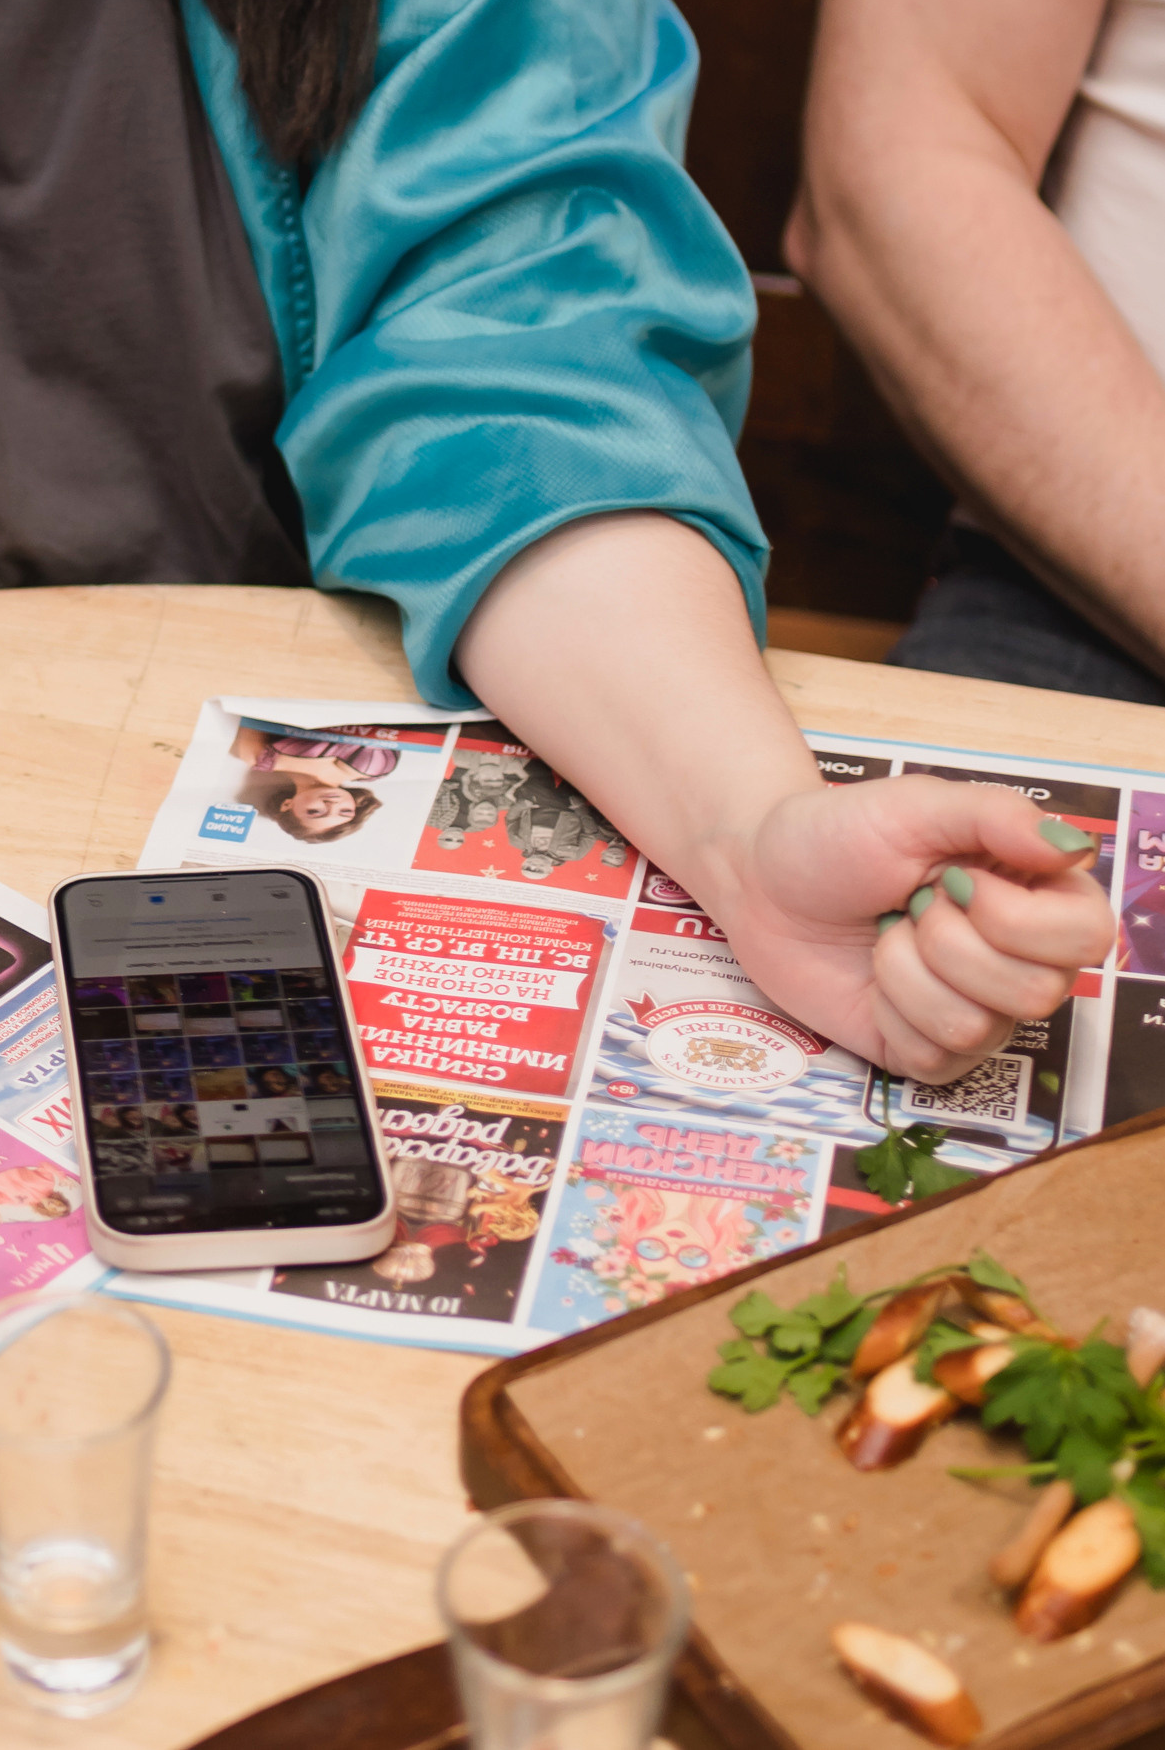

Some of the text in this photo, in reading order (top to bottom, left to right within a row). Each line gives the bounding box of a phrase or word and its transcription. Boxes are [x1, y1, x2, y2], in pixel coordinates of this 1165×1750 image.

[502, 744, 529, 756] ЛЯ
[398, 911, 441, 921] ДРУГИМИ
[451, 917, 517, 929] СУММИРУЕТСЯ
[456, 911, 509, 922] СКИДКАМИ
[520, 919, 567, 928] АКЦИЯМИ
[543, 916, 578, 925] КРОМЕ
[358, 930, 590, 968] ВС, ПН, ВТ, СР, ЧТ
[365, 918, 593, 951] КРОМЕ КОНЦЕРТНЫХ ДНЕЙ
[374, 968, 551, 1000] НА ОСНОВНОЕ
[379, 955, 556, 985] МЕНЮ КУХНИ
[14, 989, 52, 1021] ЛЮБИМОЙ
[380, 992, 531, 1022] ВОЗРАСТУ
[401, 1013, 500, 1038] РАВНА
[646, 1003, 816, 1052] ХОРОШО ТАМ, ГДЕ МЫ ЕСТЬ!
[673, 1022, 787, 1052] BRAUEREI
[6, 1048, 31, 1065] ХИТЫ
[372, 1046, 506, 1081] СКИДКА
[661, 1053, 786, 1085] MAXIMILIAN'S
[608, 1085, 636, 1095] 18+
[636, 1123, 761, 1161] ДЕНЬ
[580, 1138, 807, 1192] ЖЕНСКИЙ
[604, 1171, 774, 1201] МЕЖДУНАРОДНЫЙ
[9, 1257, 46, 1289] МАРТА
[320, 1280, 426, 1312] МАРТА
